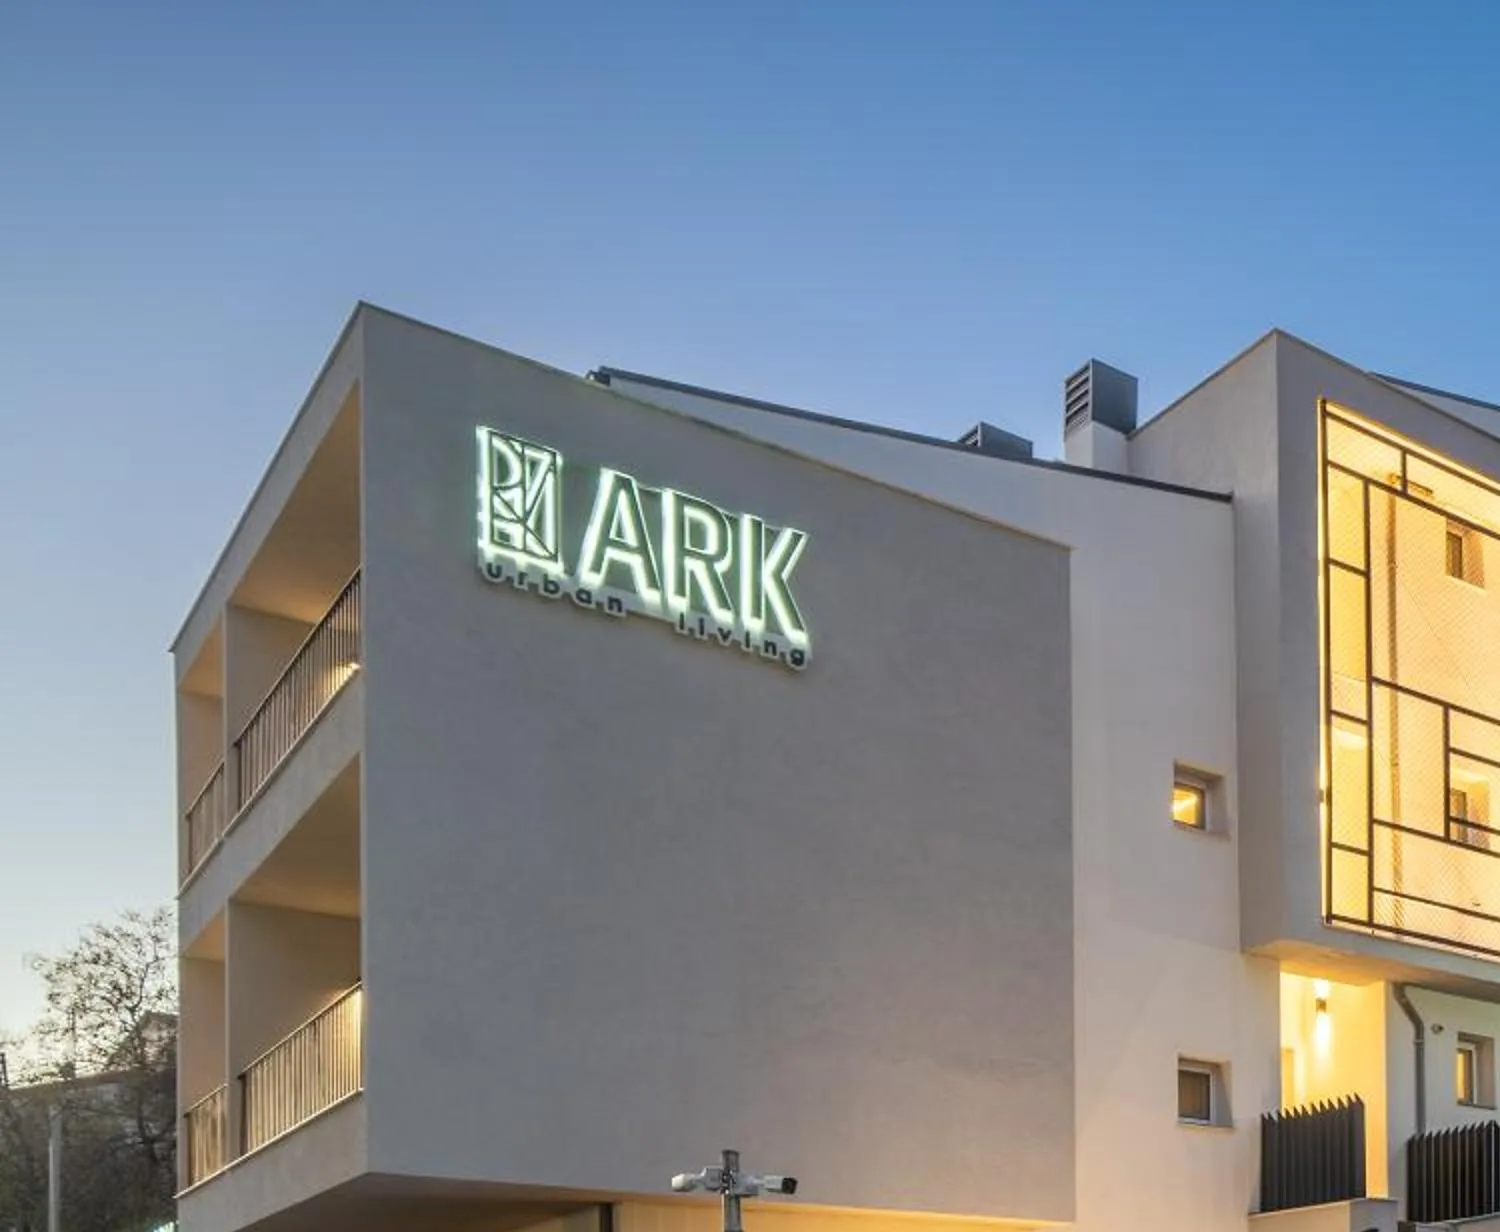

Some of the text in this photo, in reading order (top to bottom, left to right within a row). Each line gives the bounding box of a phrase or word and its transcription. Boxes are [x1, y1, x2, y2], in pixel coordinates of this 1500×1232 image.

[485, 562, 805, 666] urban living
[577, 467, 809, 642] ARK
